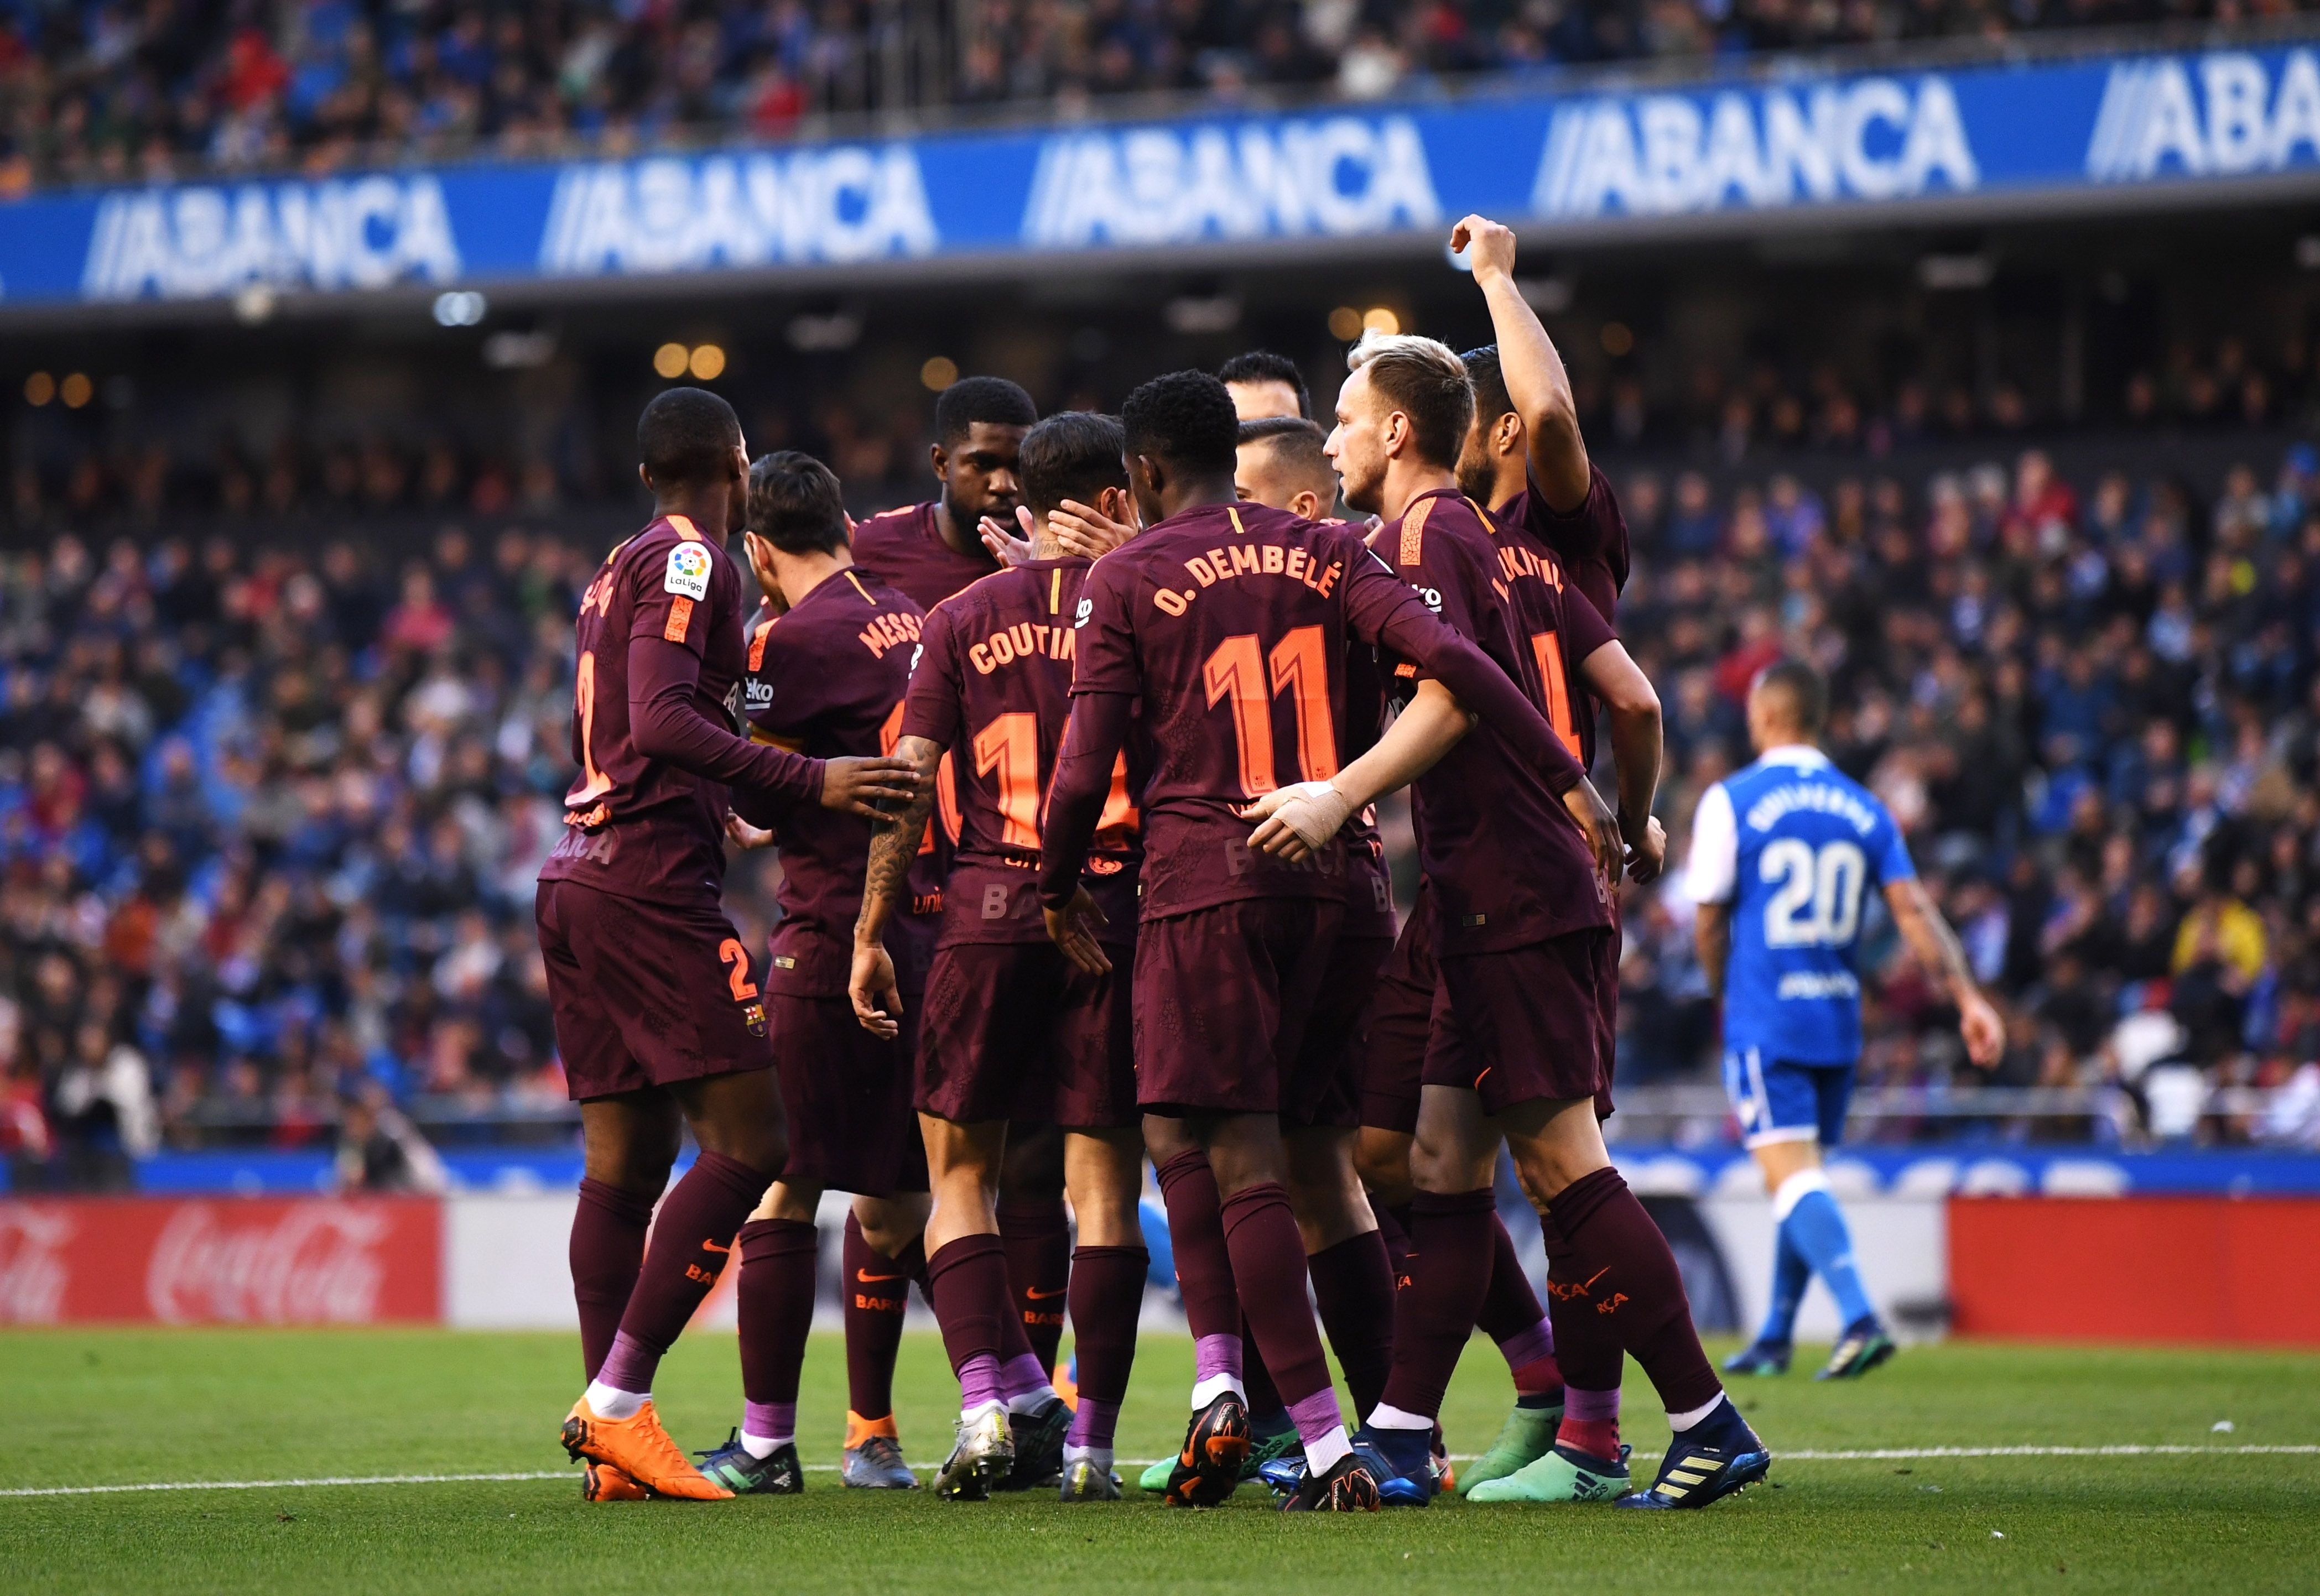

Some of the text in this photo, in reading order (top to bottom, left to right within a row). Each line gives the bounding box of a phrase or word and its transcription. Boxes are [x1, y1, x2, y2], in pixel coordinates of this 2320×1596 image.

[1532, 77, 1979, 218] ABANCA
[2087, 50, 2320, 180] ABA
[1022, 113, 1443, 249] ABANCA
[670, 576, 703, 592] LaLiga
[1154, 545, 1343, 617] O. DEMBÉLÉ
[969, 622, 1077, 675] COUTIN
[1203, 624, 1338, 800] 11
[1758, 837, 1867, 950] 20
[719, 937, 758, 1002] 2
